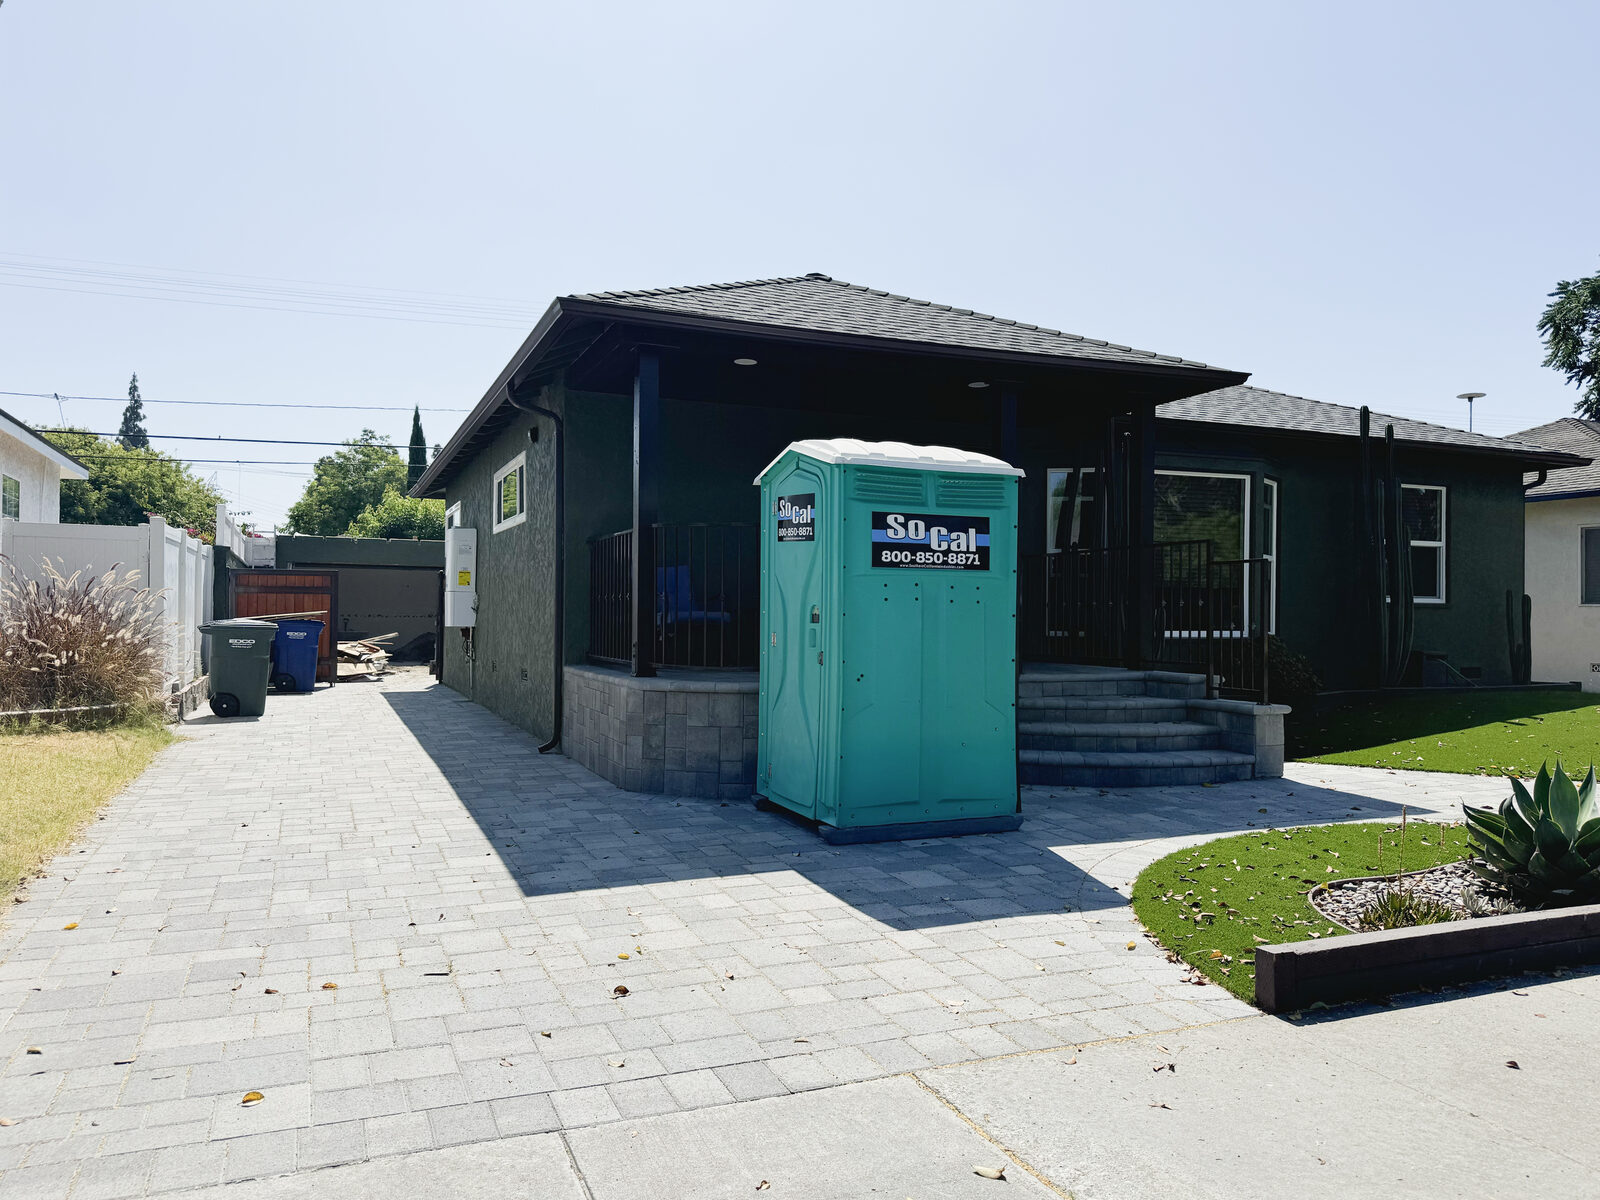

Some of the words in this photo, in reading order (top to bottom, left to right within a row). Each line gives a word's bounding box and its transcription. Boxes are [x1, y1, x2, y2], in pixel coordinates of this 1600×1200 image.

[780, 500, 791, 517] So
[792, 505, 811, 524] Cal
[778, 527, 813, 537] 800-850-8871
[886, 514, 926, 540] So
[930, 526, 976, 551] Cal
[881, 550, 981, 565] 800-850-8871
